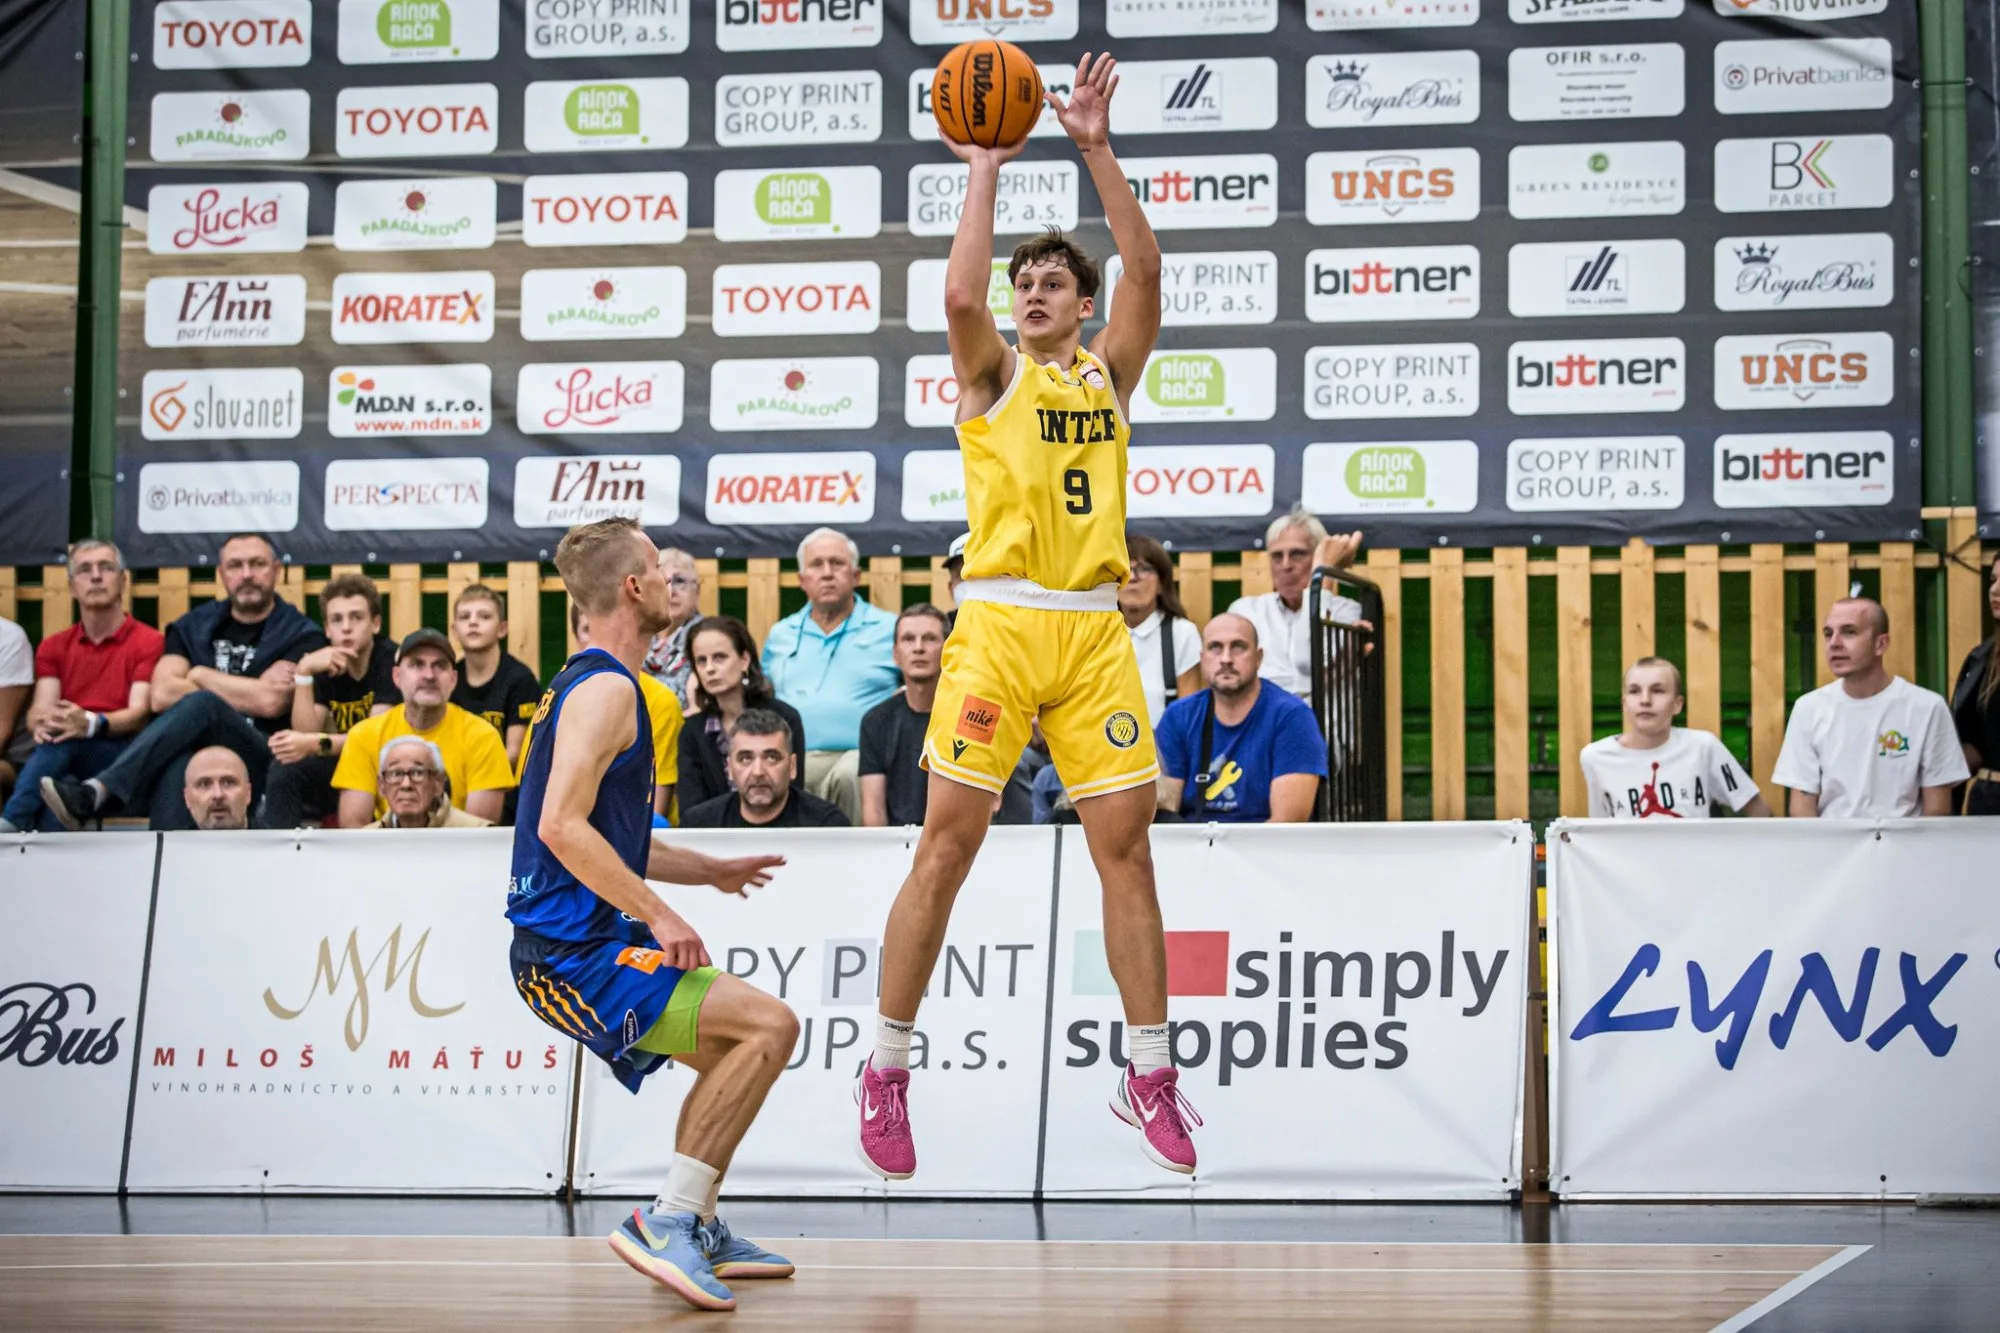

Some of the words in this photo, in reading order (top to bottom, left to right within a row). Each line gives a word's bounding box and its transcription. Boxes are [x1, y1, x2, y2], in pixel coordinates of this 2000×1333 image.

[535, 0, 600, 20] COPY
[162, 19, 303, 48] TOYOTA
[534, 23, 626, 46] GROUP,
[636, 26, 676, 42] a.s.
[1546, 51, 1592, 65] OFIR
[1599, 51, 1647, 64] s.r.o.
[1753, 66, 1887, 86] Privatbanka
[724, 86, 792, 109] COPY
[802, 82, 875, 106] PRINT
[973, 52, 994, 129] Wilson
[344, 106, 489, 136] TOYOTA
[578, 108, 623, 130] RAČA
[724, 112, 818, 135] GROUP,
[828, 114, 868, 131] a.s.
[176, 127, 287, 148] PARADAJKOVO
[918, 174, 969, 197] COP
[998, 172, 1071, 195] PRINT
[1331, 168, 1454, 200] UNCS
[173, 189, 278, 249] Lucka
[531, 194, 679, 224] TOYOTA
[768, 199, 815, 219] RAČA
[1023, 203, 1064, 220] a.s.
[361, 216, 471, 237] PARADAJKOVO
[1195, 263, 1270, 286] PRINT
[1314, 262, 1471, 295] bittner
[340, 290, 483, 325] KORATEX
[721, 284, 872, 314] TOYOTA
[1221, 294, 1262, 312] a.s.
[547, 306, 660, 326] PARADAJKOVO
[176, 324, 270, 341] parfumérie
[1315, 357, 1385, 379] COPY
[1395, 354, 1471, 378] PRINT
[1517, 354, 1676, 387] bittner
[1740, 352, 1867, 384] UNCS
[543, 368, 652, 427] Lucka
[1160, 379, 1207, 400] RAČA
[1314, 384, 1412, 407] GROUP,
[1423, 386, 1464, 404] a.s.
[194, 384, 294, 429] slovanet
[425, 399, 484, 412] s.r.o.
[737, 397, 852, 417] PARADAJKOVO
[355, 416, 481, 431] www.mdn.sk
[1037, 408, 1115, 444] INTER
[1517, 451, 1590, 473] COPY
[1599, 448, 1677, 471] PRINT
[1723, 448, 1885, 481] bittner
[715, 470, 863, 505] KORATEX
[1063, 468, 1093, 515] 9
[1127, 466, 1264, 495] OYOTA
[1359, 471, 1407, 492] RAČA
[1516, 477, 1616, 500] GROUP,
[1626, 479, 1669, 497] a.s.
[174, 488, 292, 507] Privatbanka
[333, 483, 479, 507] PERSPECTA
[727, 946, 806, 998] PY
[1235, 930, 1509, 1017] simply
[1569, 942, 1968, 1072] LYNX
[153, 1042, 314, 1068] MILOŠ
[389, 1043, 558, 1070] MÁŤUŠ
[152, 1081, 373, 1095] VINOHRADNÍCTVO
[392, 1083, 402, 1095] A
